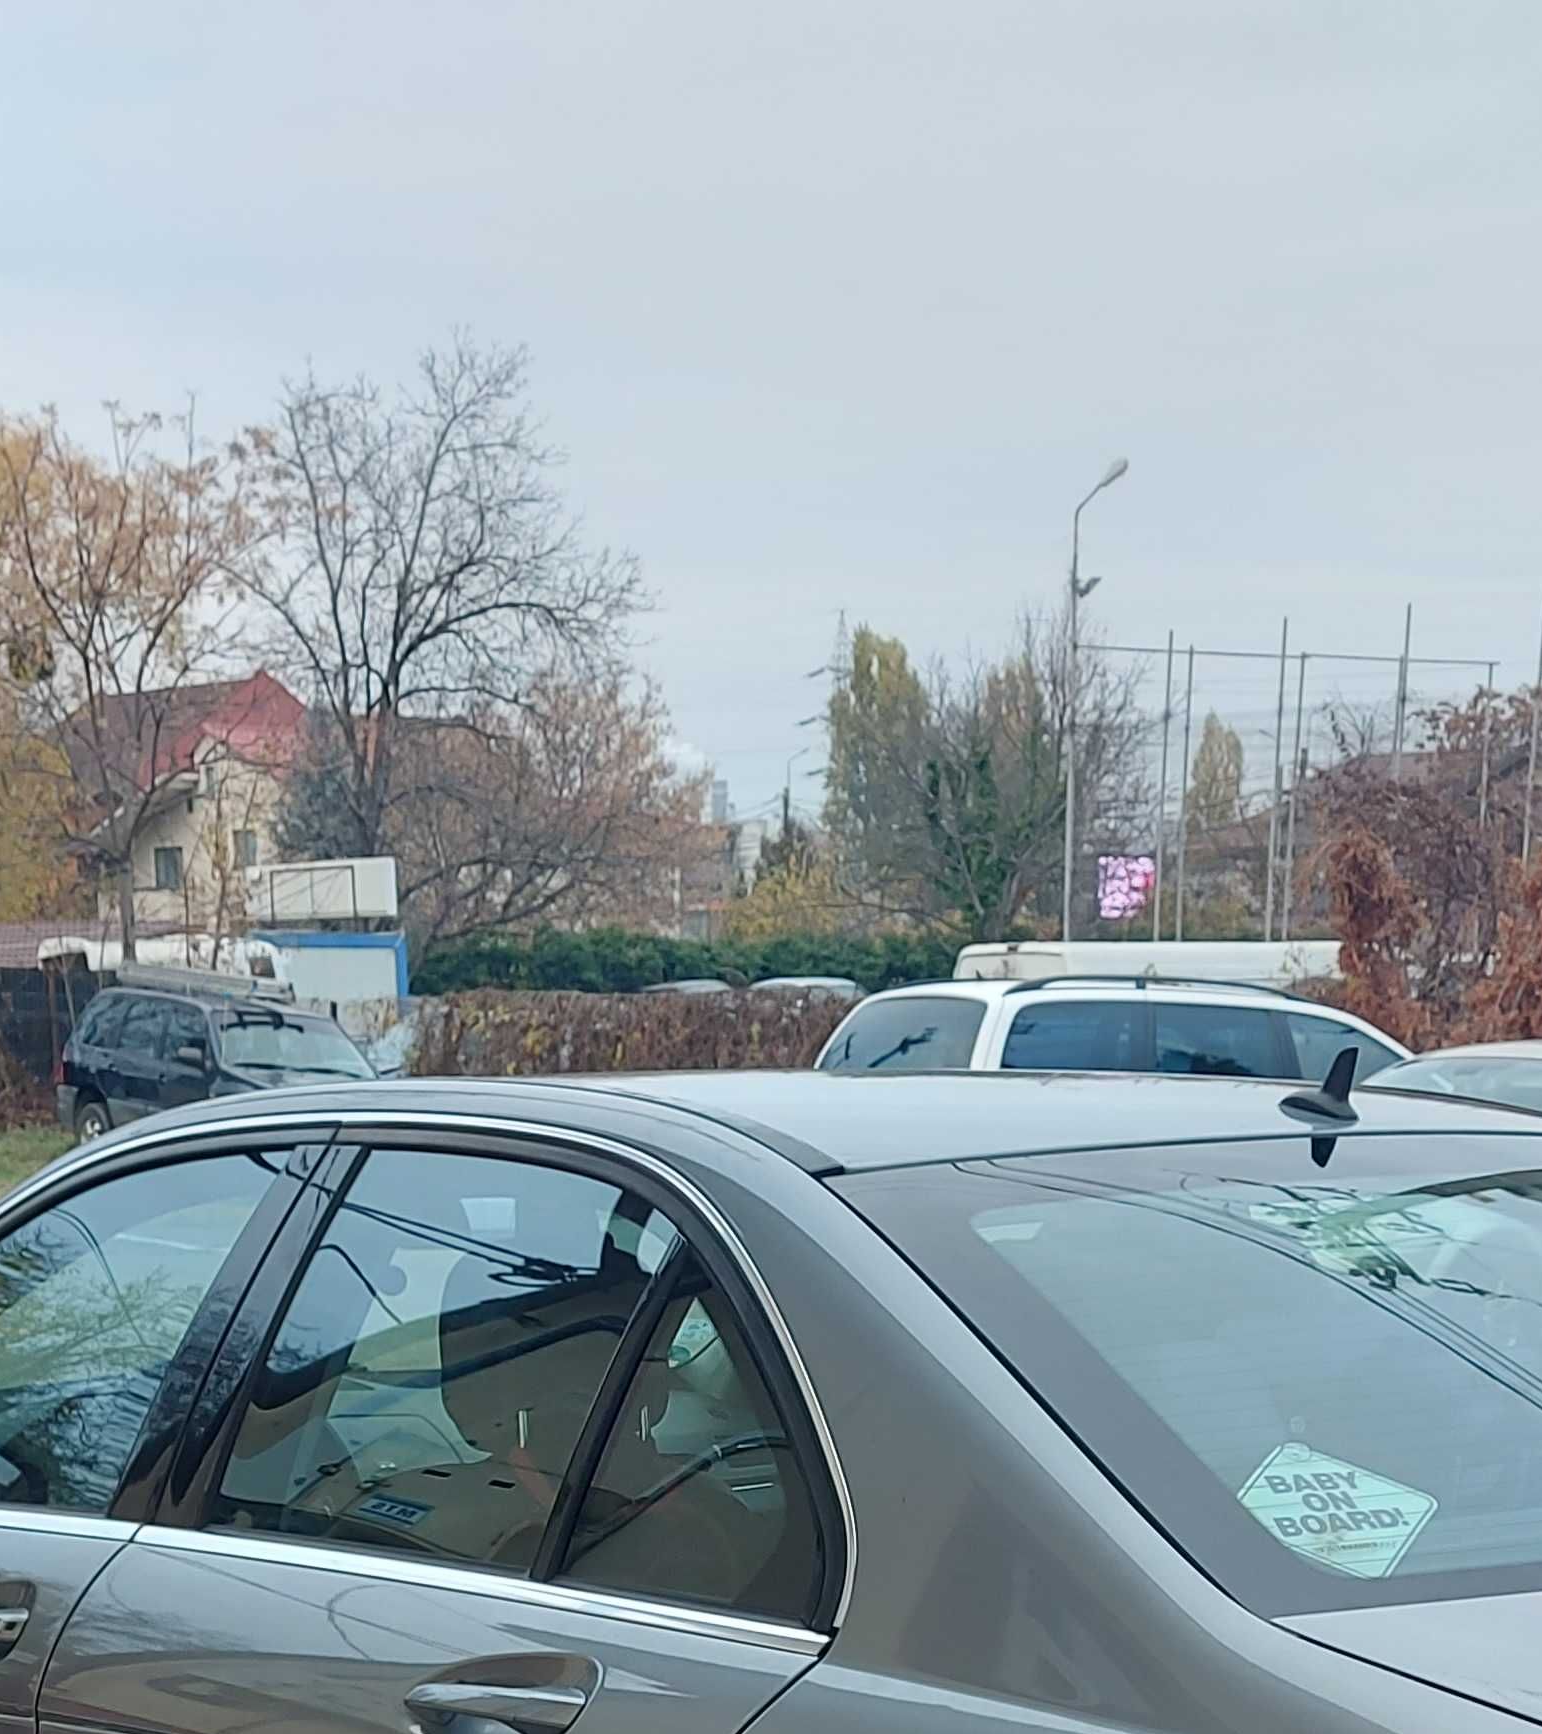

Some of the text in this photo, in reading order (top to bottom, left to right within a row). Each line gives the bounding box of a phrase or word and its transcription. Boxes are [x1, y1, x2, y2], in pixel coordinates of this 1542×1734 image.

[1264, 1471, 1358, 1494] BABY
[1301, 1490, 1358, 1512] ON
[1272, 1507, 1411, 1538] BOARD!
